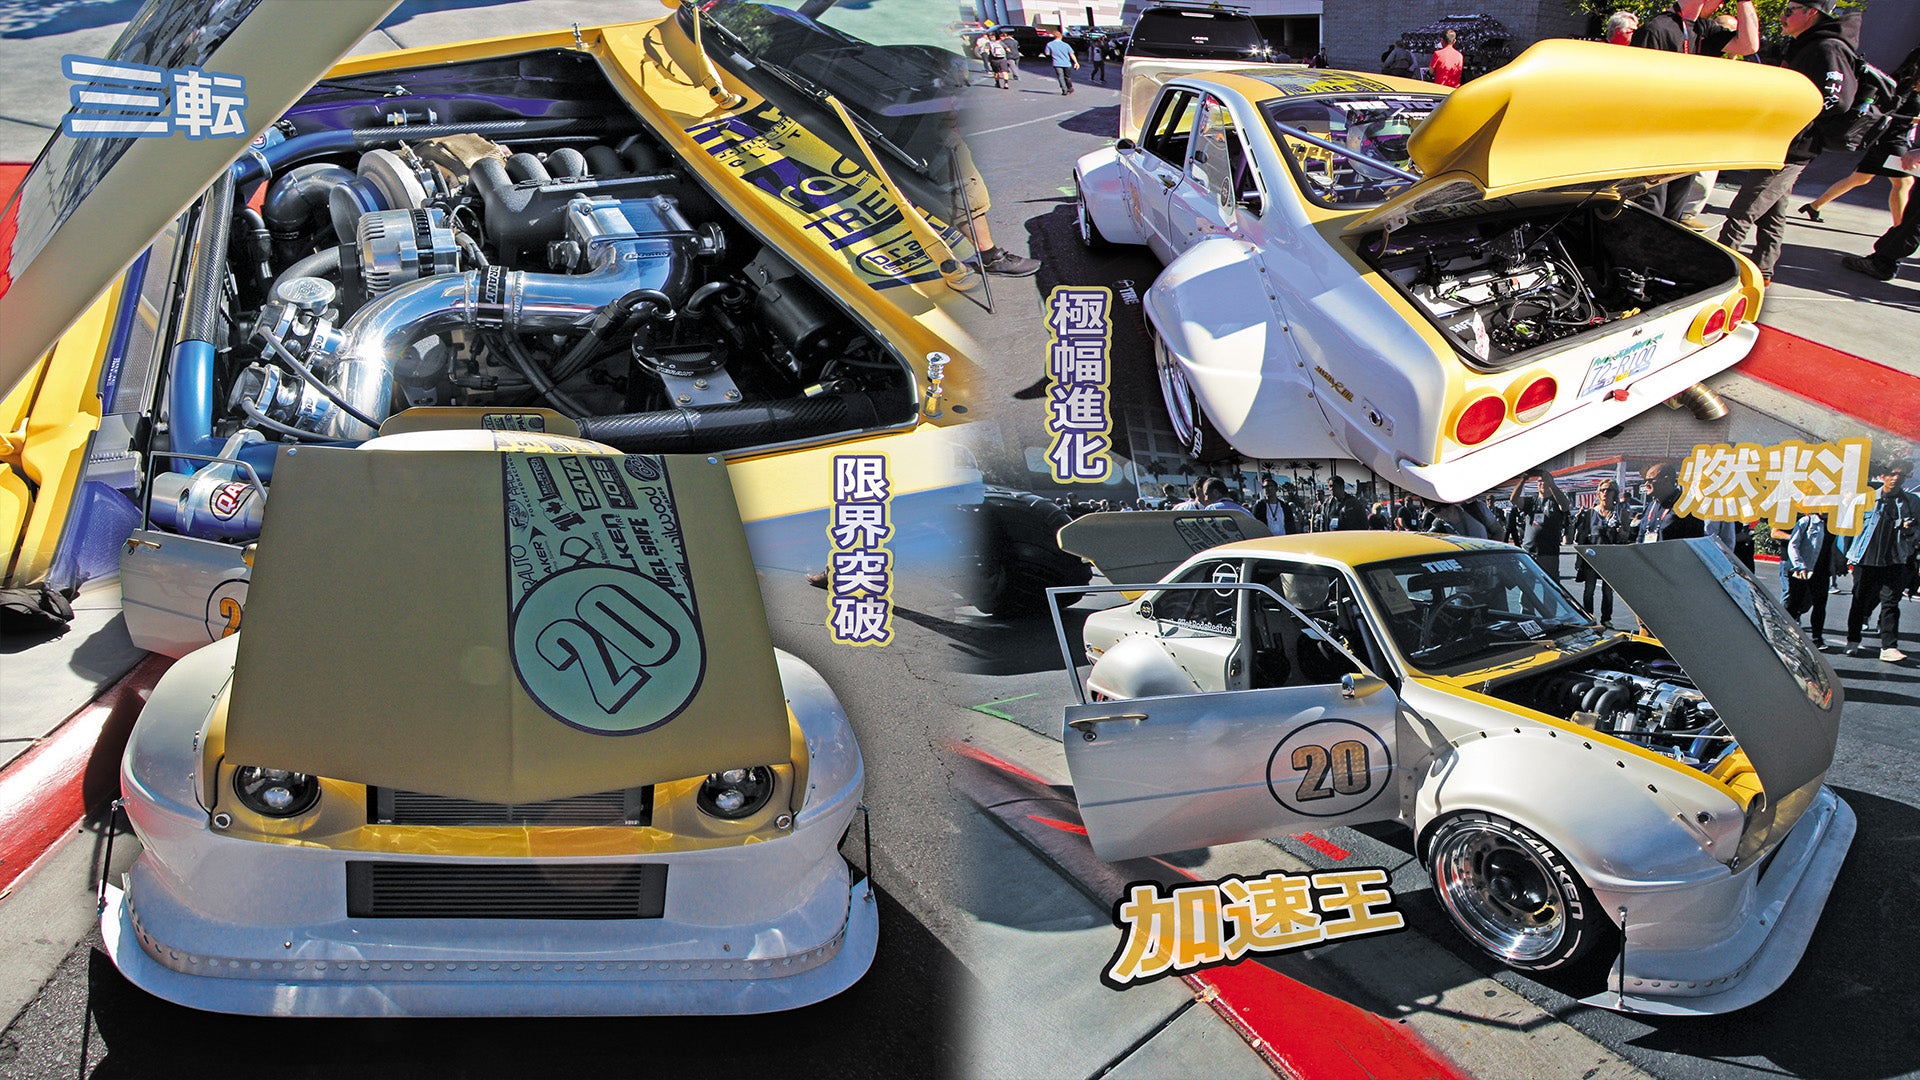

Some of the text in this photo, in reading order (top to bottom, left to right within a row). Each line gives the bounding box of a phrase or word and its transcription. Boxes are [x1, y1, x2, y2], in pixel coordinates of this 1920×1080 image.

[562, 456, 597, 508] SATA
[594, 458, 627, 509] JOES
[628, 516, 660, 557] SAFE
[1421, 559, 1463, 574] TIRE
[535, 583, 682, 715] 20
[1291, 738, 1371, 803] 20
[1511, 826, 1585, 921] FALKEN
